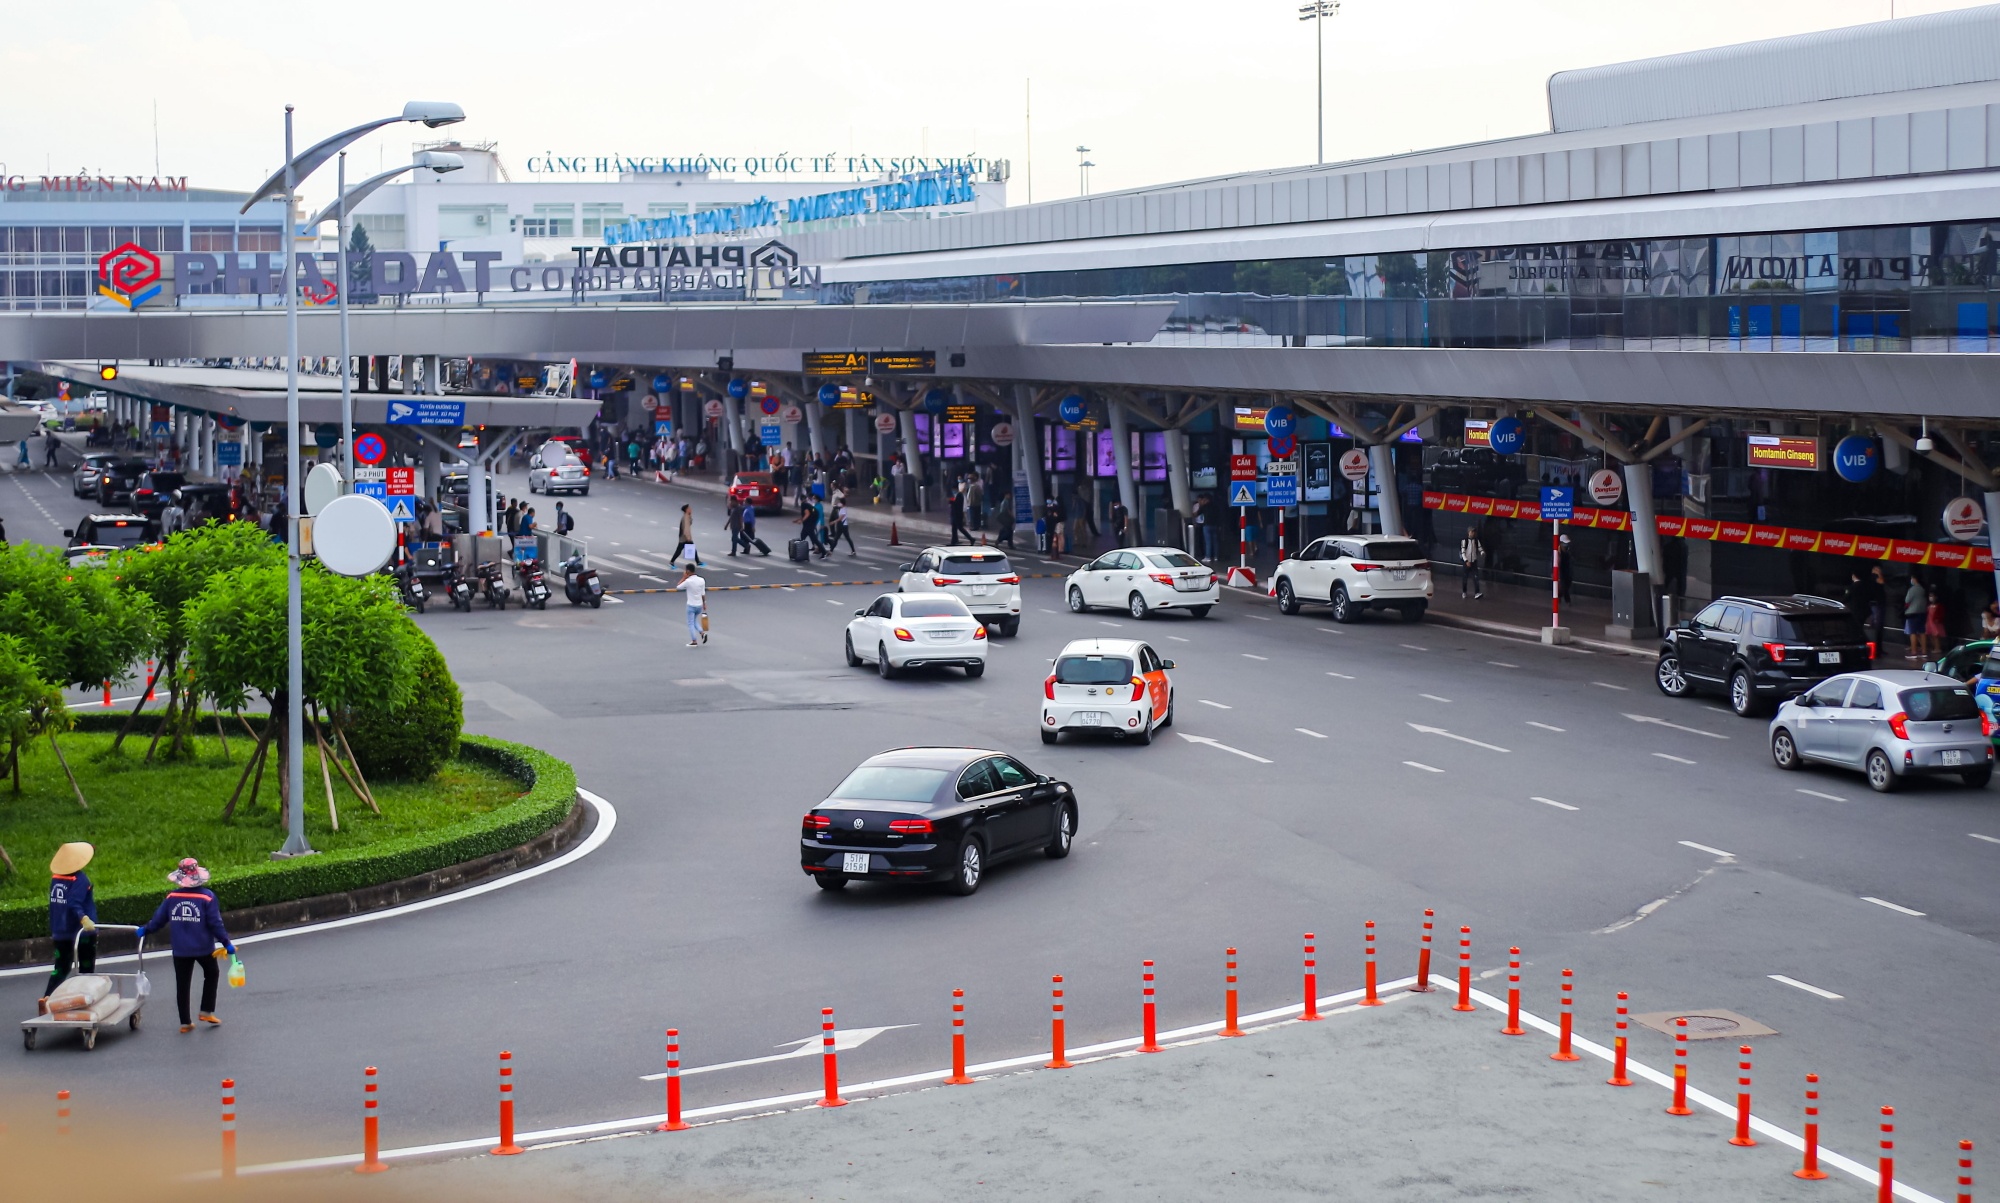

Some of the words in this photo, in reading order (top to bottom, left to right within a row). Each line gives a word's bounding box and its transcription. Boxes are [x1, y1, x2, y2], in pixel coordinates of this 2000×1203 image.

[527, 150, 587, 173] CẢNG
[595, 152, 654, 173] HÀNG
[662, 152, 737, 173] KHÔNG
[744, 151, 803, 176] QUỐC
[810, 151, 836, 173] TẾ
[845, 153, 885, 173] TÂN
[891, 155, 929, 174] SƠN
[38, 166, 115, 192] MIỀN
[124, 175, 188, 192] NAM
[510, 265, 822, 293] CORPORATION
[846, 354, 857, 366] A
[1270, 419, 1288, 428] VIB
[1468, 429, 1490, 440] Homtami
[1496, 433, 1516, 443] VIB
[1753, 446, 1786, 459] Homtamin
[1787, 449, 1814, 462] Ginseng
[1236, 457, 1251, 466] CẤM
[1843, 455, 1867, 466] VIB
[393, 469, 408, 478] CẤM
[1271, 478, 1286, 488] LÀN
[850, 853, 864, 862] 51H
